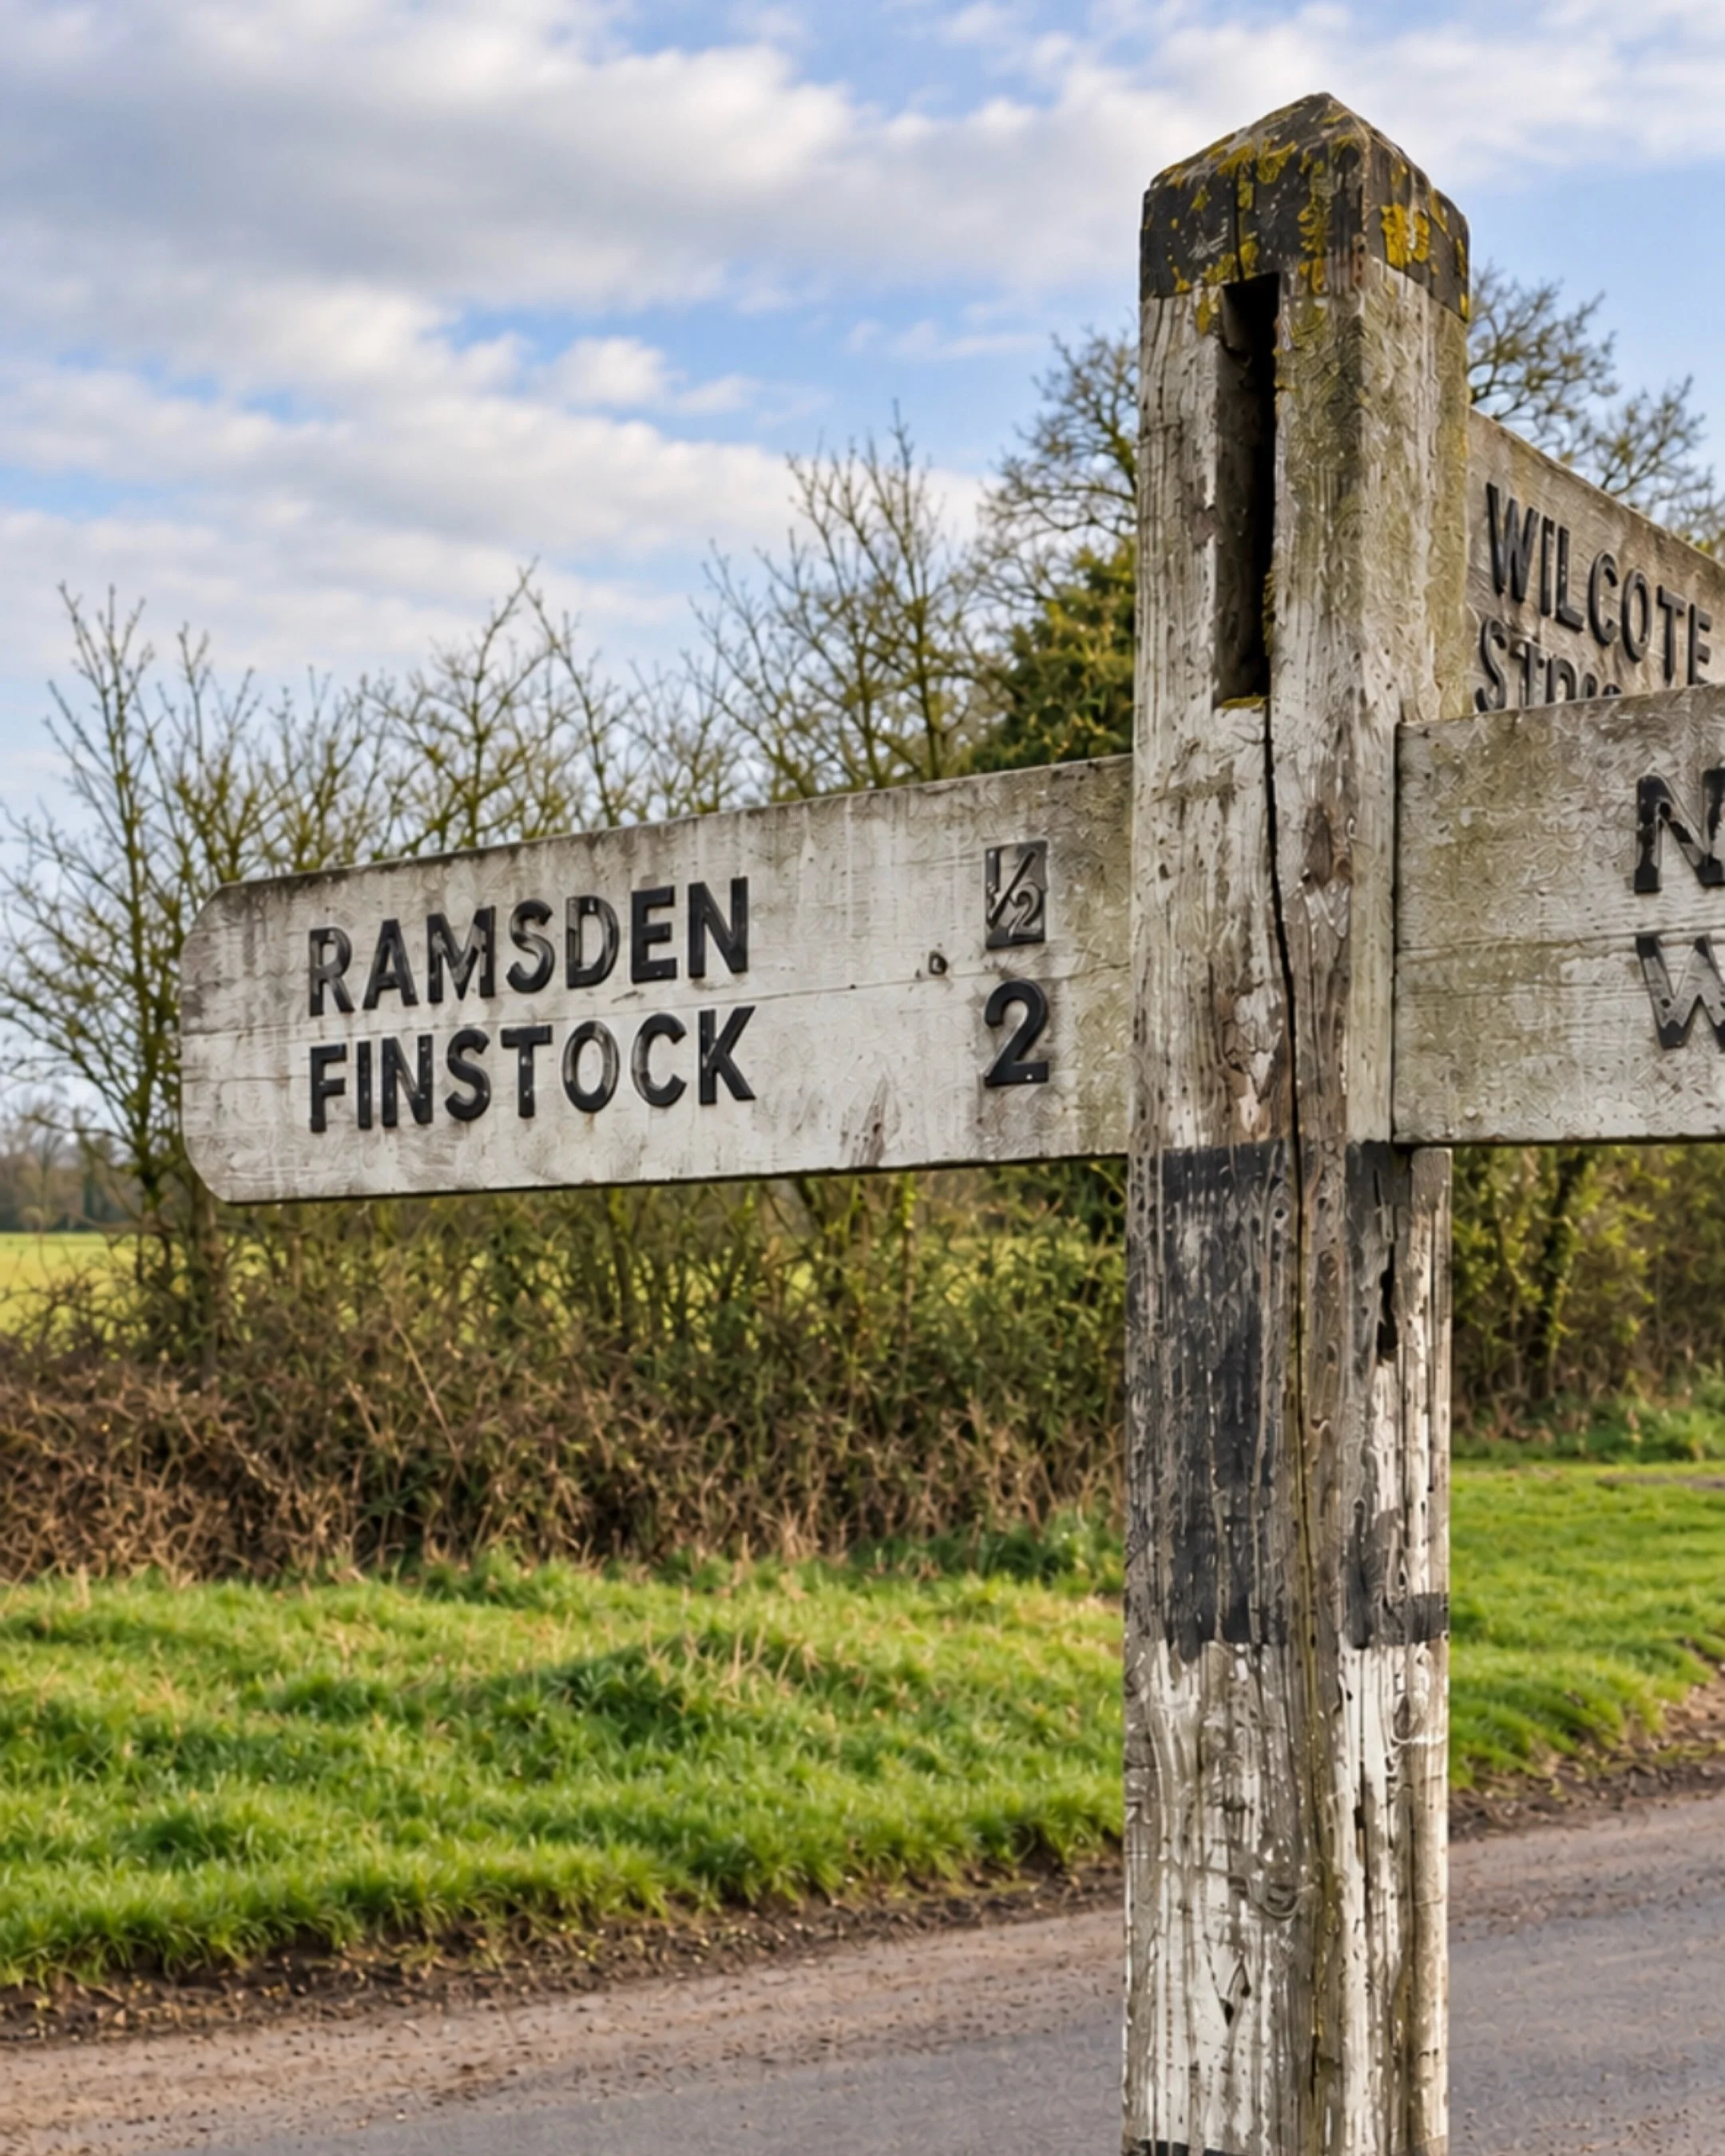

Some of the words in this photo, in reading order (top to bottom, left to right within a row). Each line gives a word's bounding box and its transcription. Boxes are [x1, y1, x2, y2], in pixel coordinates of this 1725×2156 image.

[1486, 482, 1712, 687] WILCOTE
[308, 877, 749, 1017] RAMSDEN
[309, 1005, 756, 1134] FINSTOCK
[984, 978, 1049, 1088] 2
